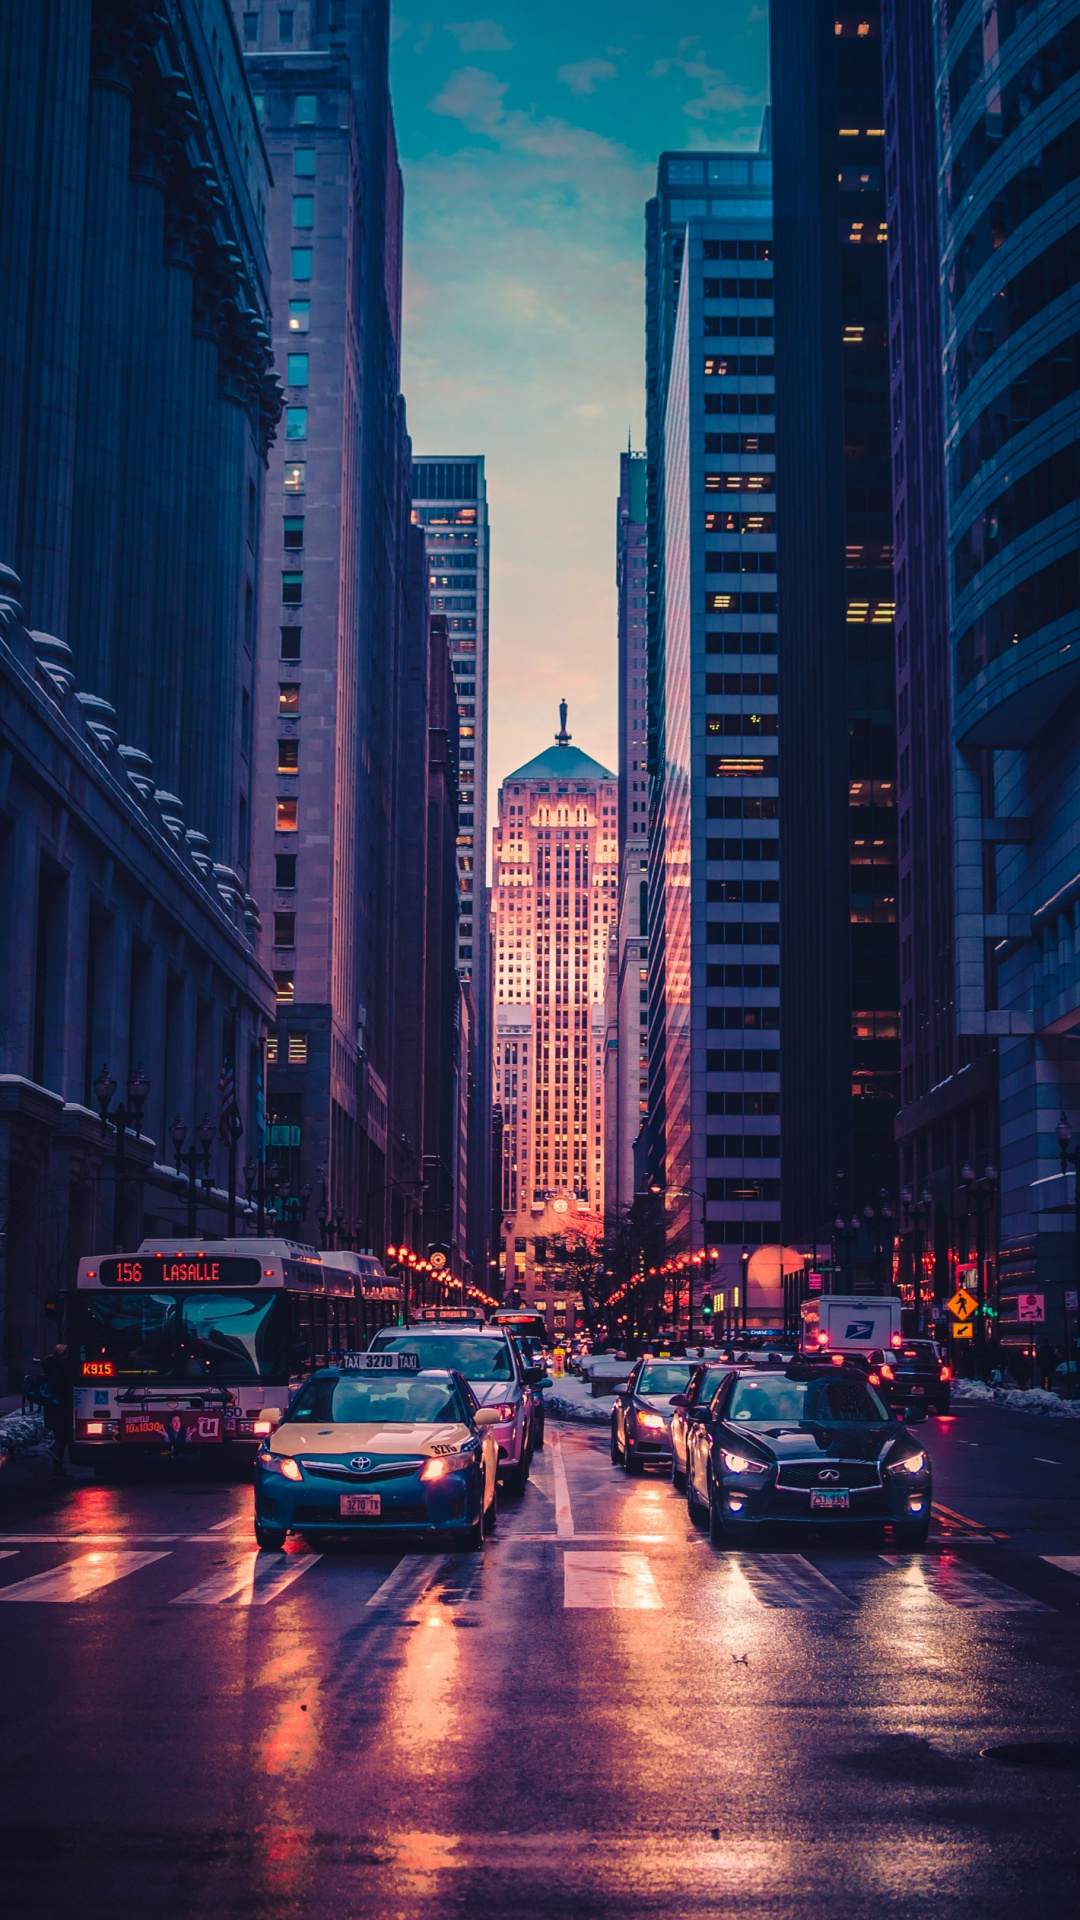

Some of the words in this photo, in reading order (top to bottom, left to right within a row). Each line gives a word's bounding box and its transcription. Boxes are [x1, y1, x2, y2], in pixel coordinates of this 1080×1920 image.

[116, 1263, 143, 1282] 156
[163, 1263, 220, 1281] LASALLE
[366, 1355, 393, 1367] 3270
[399, 1355, 417, 1368] TAXI
[83, 1362, 112, 1375] K915
[125, 1415, 150, 1424] SEINFELD
[347, 1500, 366, 1510] 3270
[369, 1500, 379, 1510] TX
